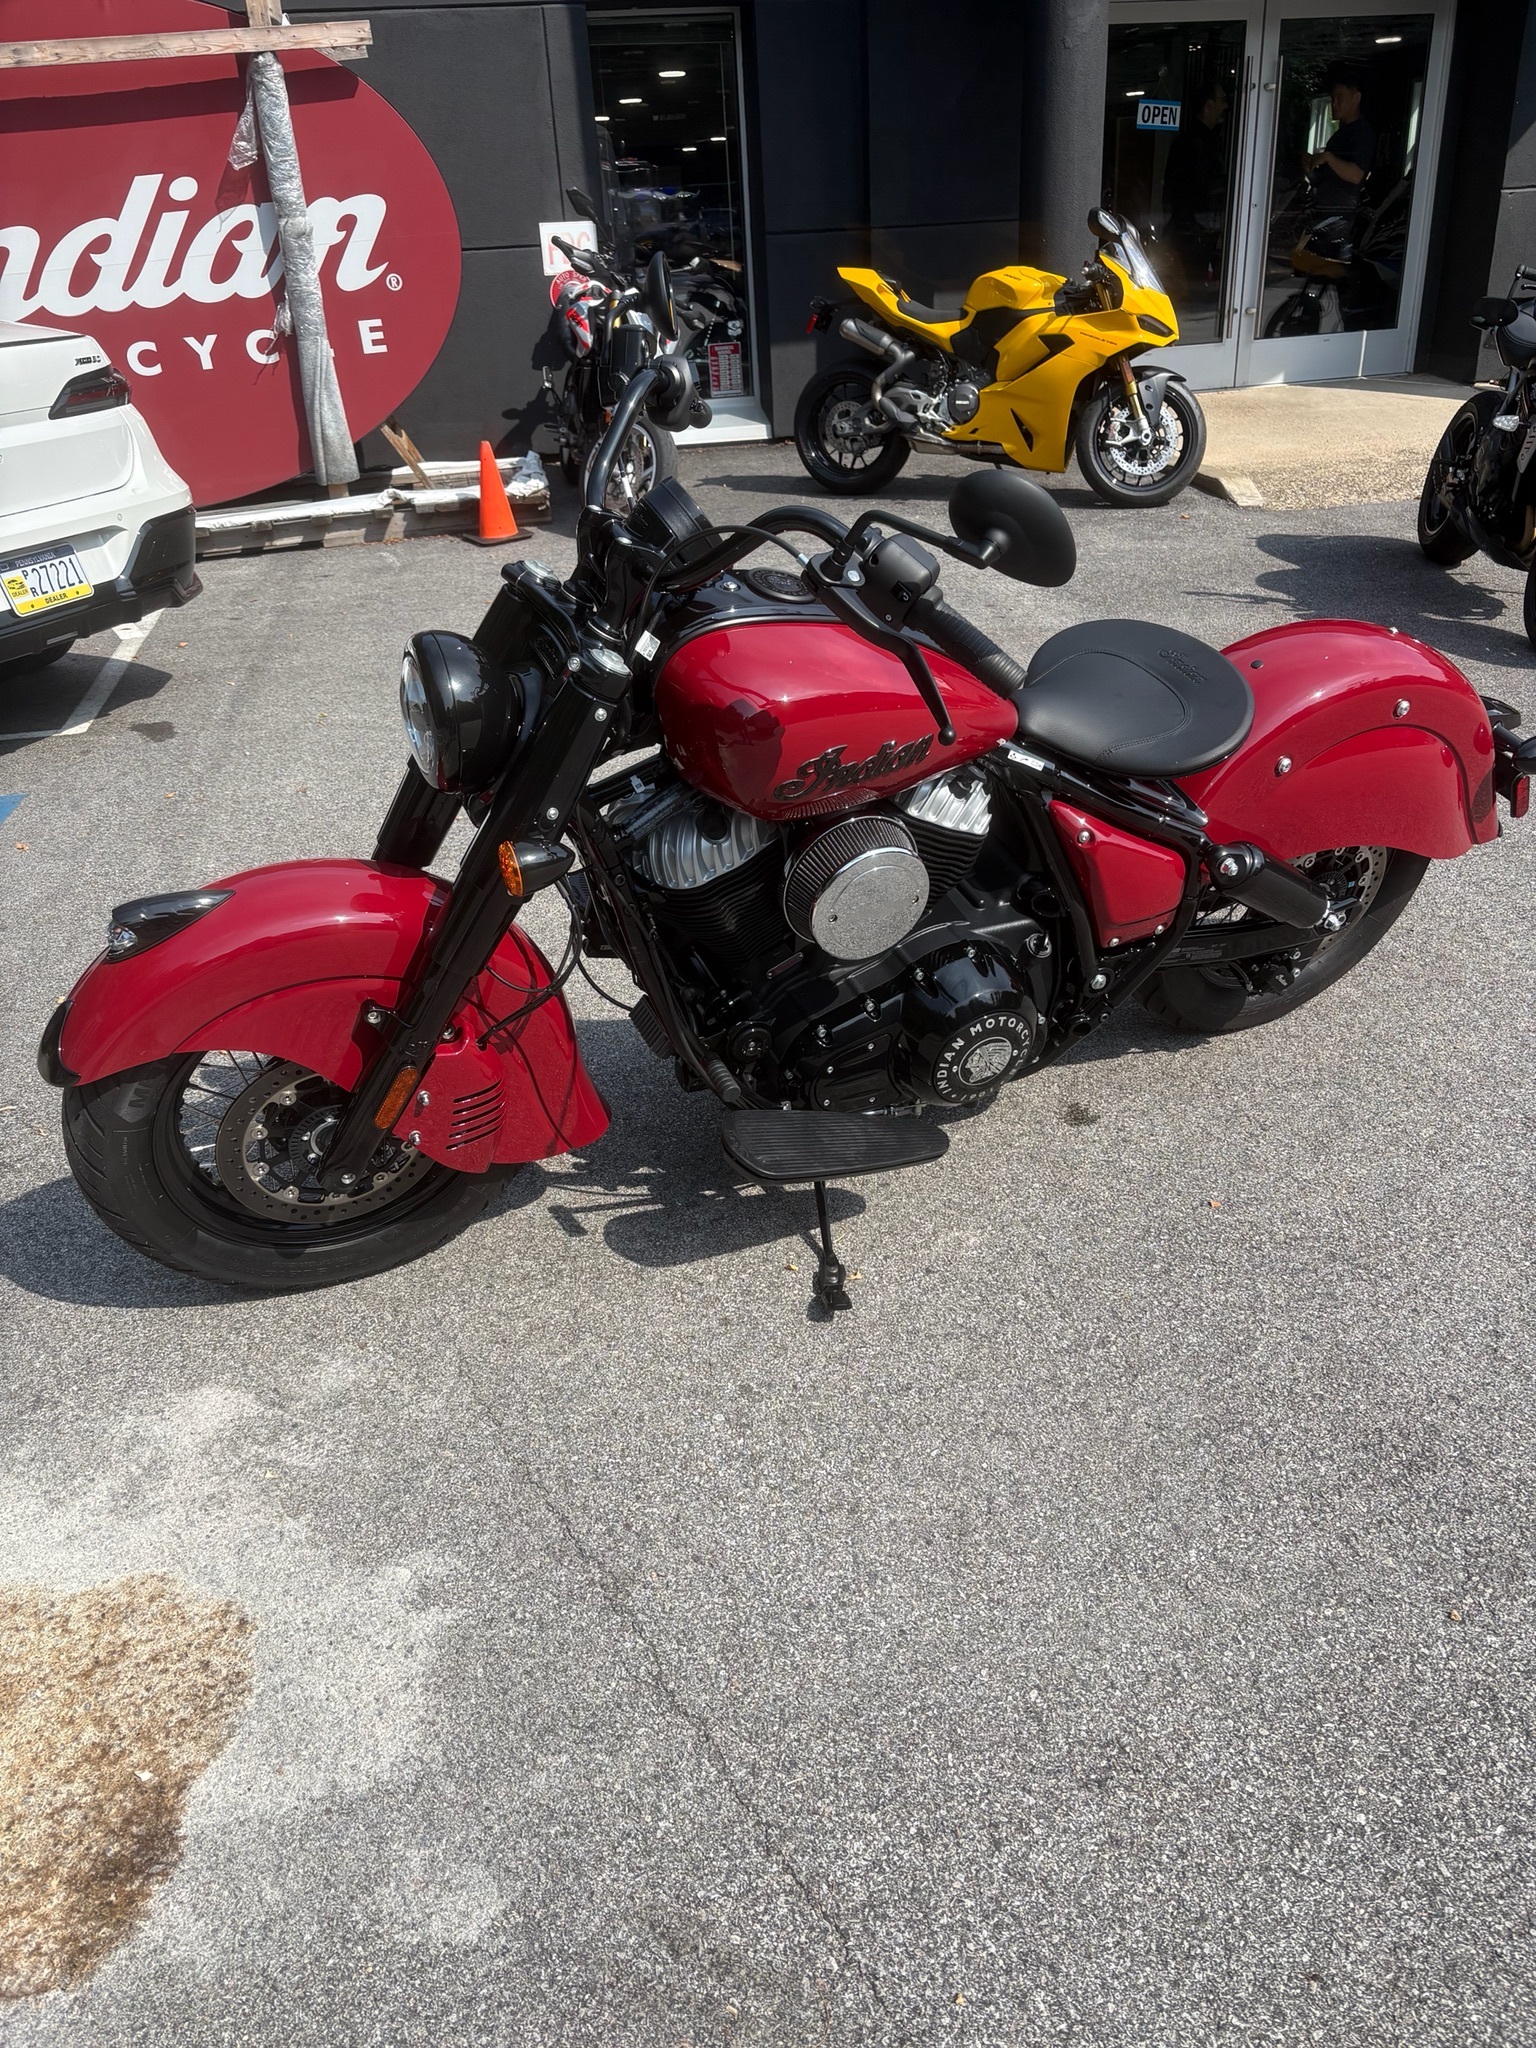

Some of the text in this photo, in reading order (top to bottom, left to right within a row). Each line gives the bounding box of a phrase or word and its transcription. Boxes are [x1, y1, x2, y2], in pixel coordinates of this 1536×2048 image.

[1141, 104, 1178, 126] OPEN
[0, 173, 389, 322] ndian
[126, 318, 389, 377] CYCE
[15, 552, 57, 568] PENNSYLVANIA
[12, 588, 29, 598] DEALER
[45, 592, 69, 604] DEALER
[774, 733, 934, 800] Indian
[937, 1037, 965, 1094] INDIAN
